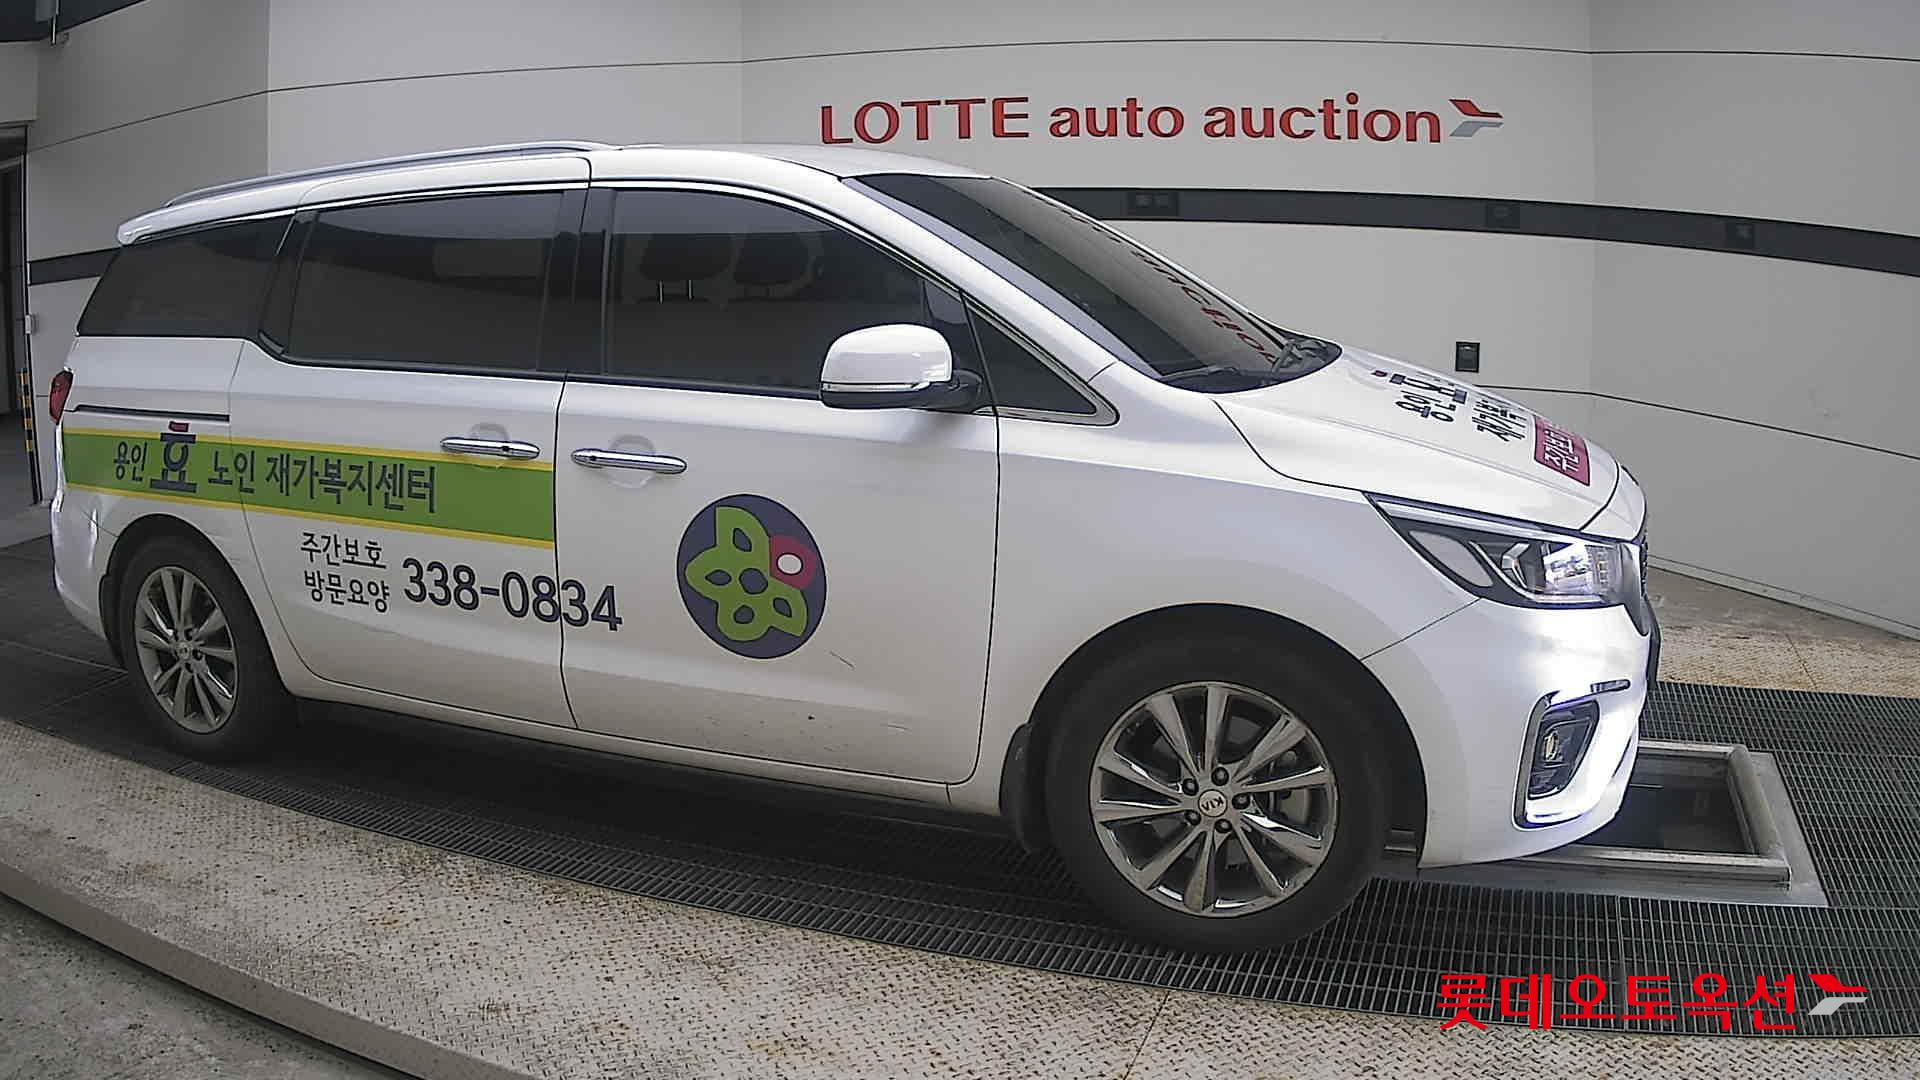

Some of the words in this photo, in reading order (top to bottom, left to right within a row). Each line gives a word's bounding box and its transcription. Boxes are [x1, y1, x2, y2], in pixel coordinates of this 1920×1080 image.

[821, 97, 1030, 144] LOTTE
[1048, 97, 1185, 139] auto
[1204, 92, 1441, 143] auction
[113, 441, 147, 481] 용인
[150, 421, 197, 493] 효
[208, 450, 255, 494] 노인
[265, 453, 436, 513] 재가복지센터
[301, 531, 386, 569] 주간보호
[304, 570, 389, 613] 방문요양
[402, 557, 623, 632] 338-0834
